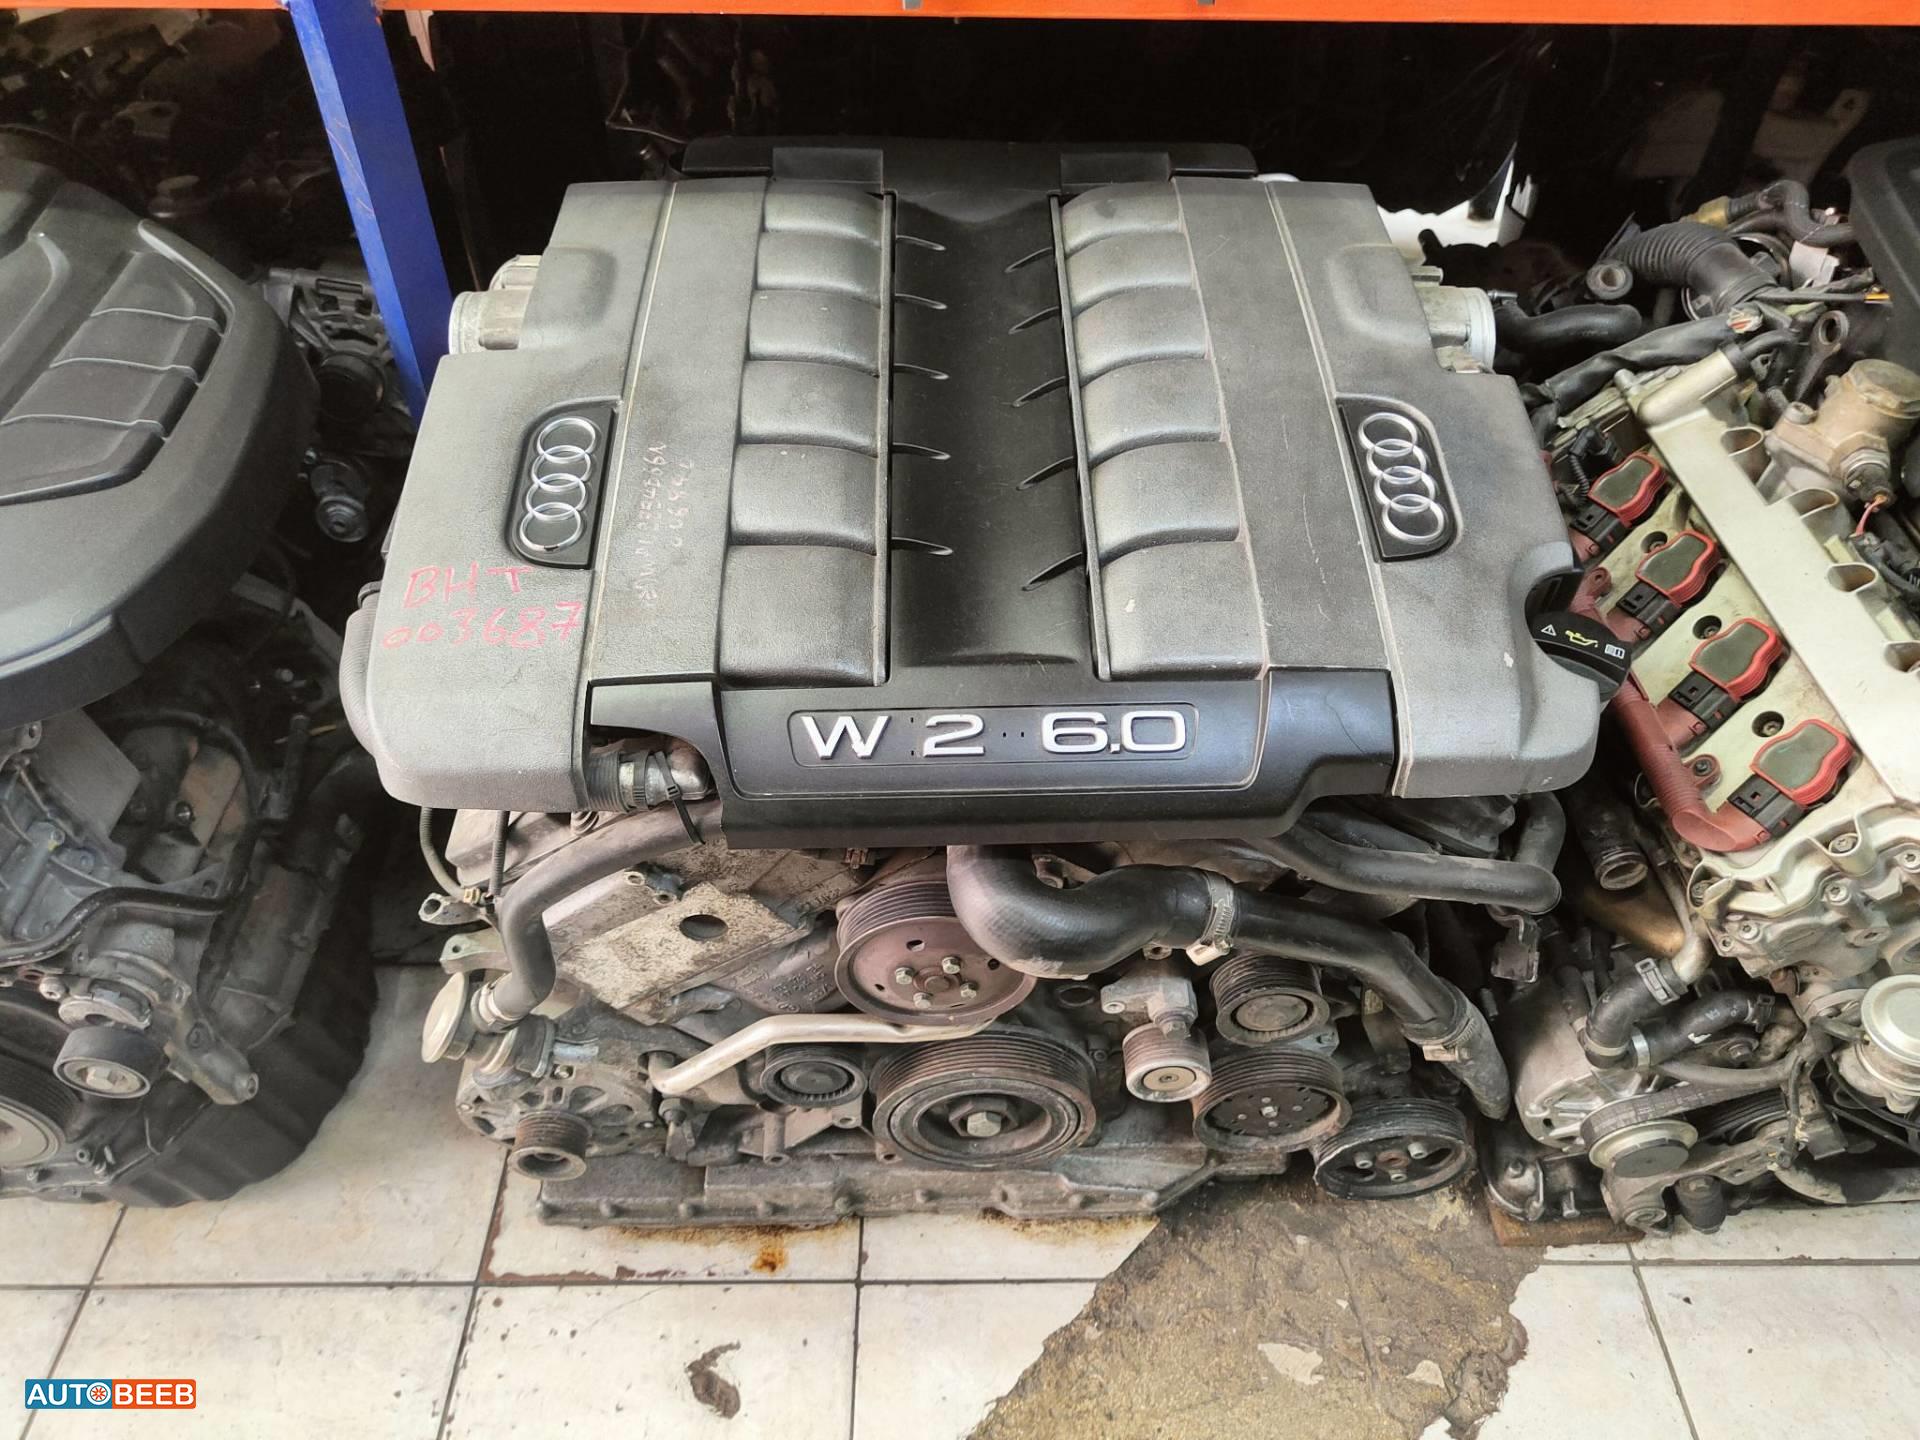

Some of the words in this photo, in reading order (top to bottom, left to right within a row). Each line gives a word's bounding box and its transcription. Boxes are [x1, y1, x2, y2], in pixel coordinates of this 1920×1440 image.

[402, 560, 534, 609] BHT
[381, 601, 584, 650] 003687
[801, 715, 891, 760] W
[1041, 710, 1187, 754] 6.0
